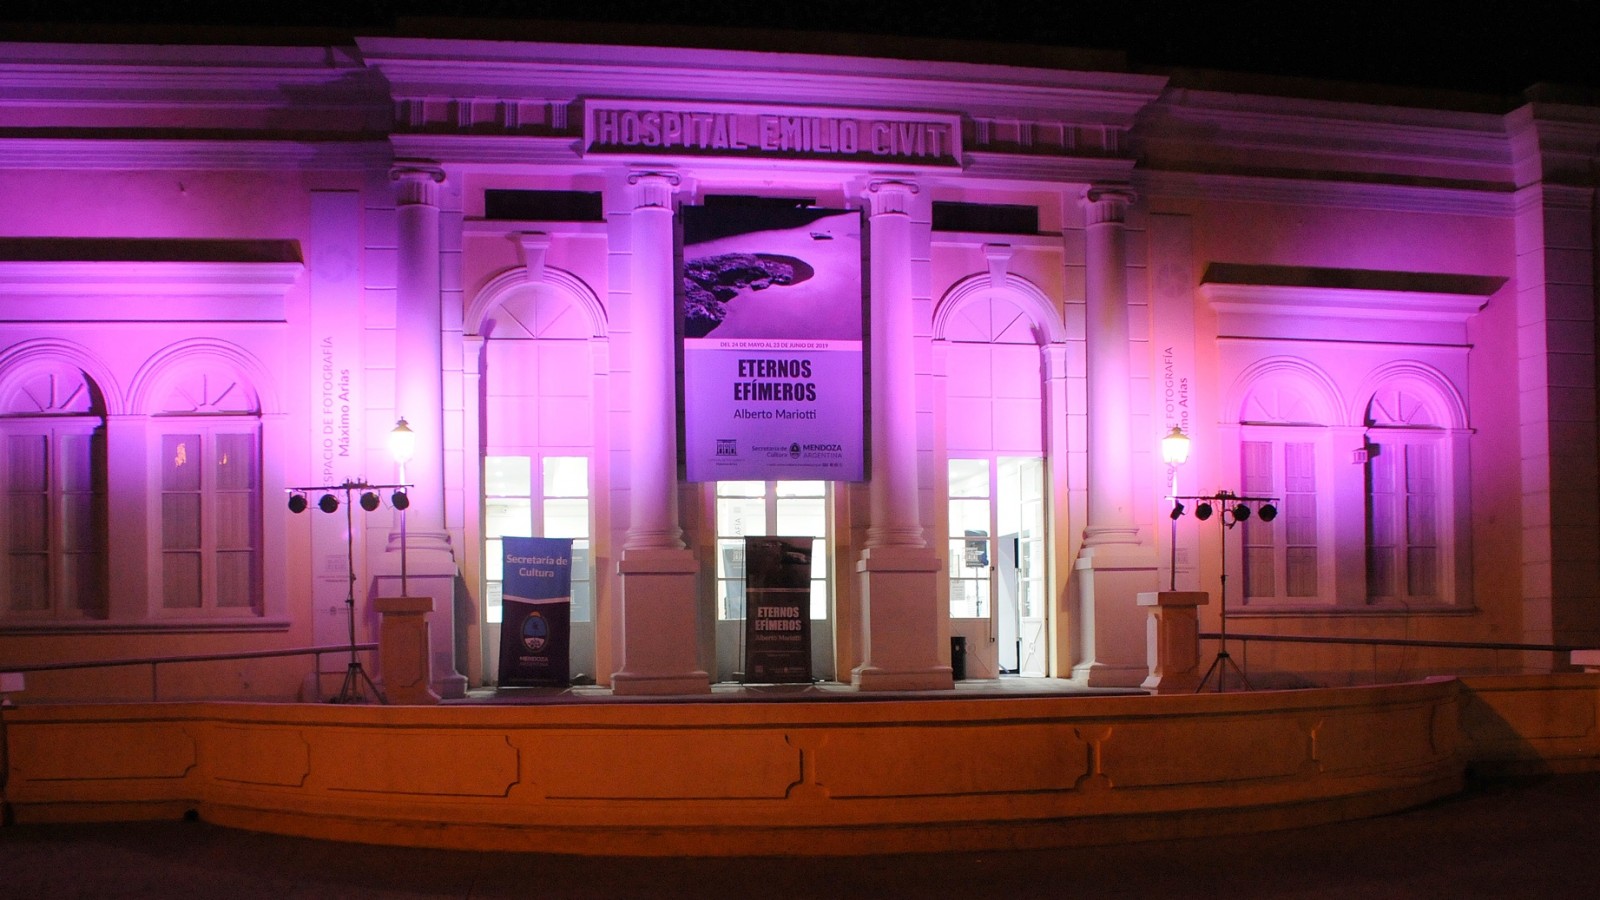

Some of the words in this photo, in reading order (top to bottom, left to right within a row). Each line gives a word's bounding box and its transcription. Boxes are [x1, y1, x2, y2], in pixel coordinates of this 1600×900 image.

[599, 108, 748, 151] HOSPITAL
[760, 114, 859, 155] EMILIO
[870, 124, 947, 157] CIVIT
[320, 336, 333, 415] FOTOGRAFÍA
[738, 359, 812, 378] ETERNOS
[337, 369, 349, 401] Arias
[733, 379, 817, 402] EFÍMEROS
[1162, 346, 1174, 419] FOTOGRAFÍA
[1178, 377, 1188, 408] Arias
[733, 409, 773, 420] Alberto
[775, 409, 817, 420] Mariotti
[323, 418, 333, 435] DE
[337, 405, 349, 457] Máximo
[803, 444, 842, 452] MENDOZA
[506, 554, 554, 565] Secretaría
[555, 556, 568, 566] de
[519, 567, 555, 578] Cultura
[757, 606, 799, 618] ETERNOS
[755, 618, 802, 631] EFÍMEROS
